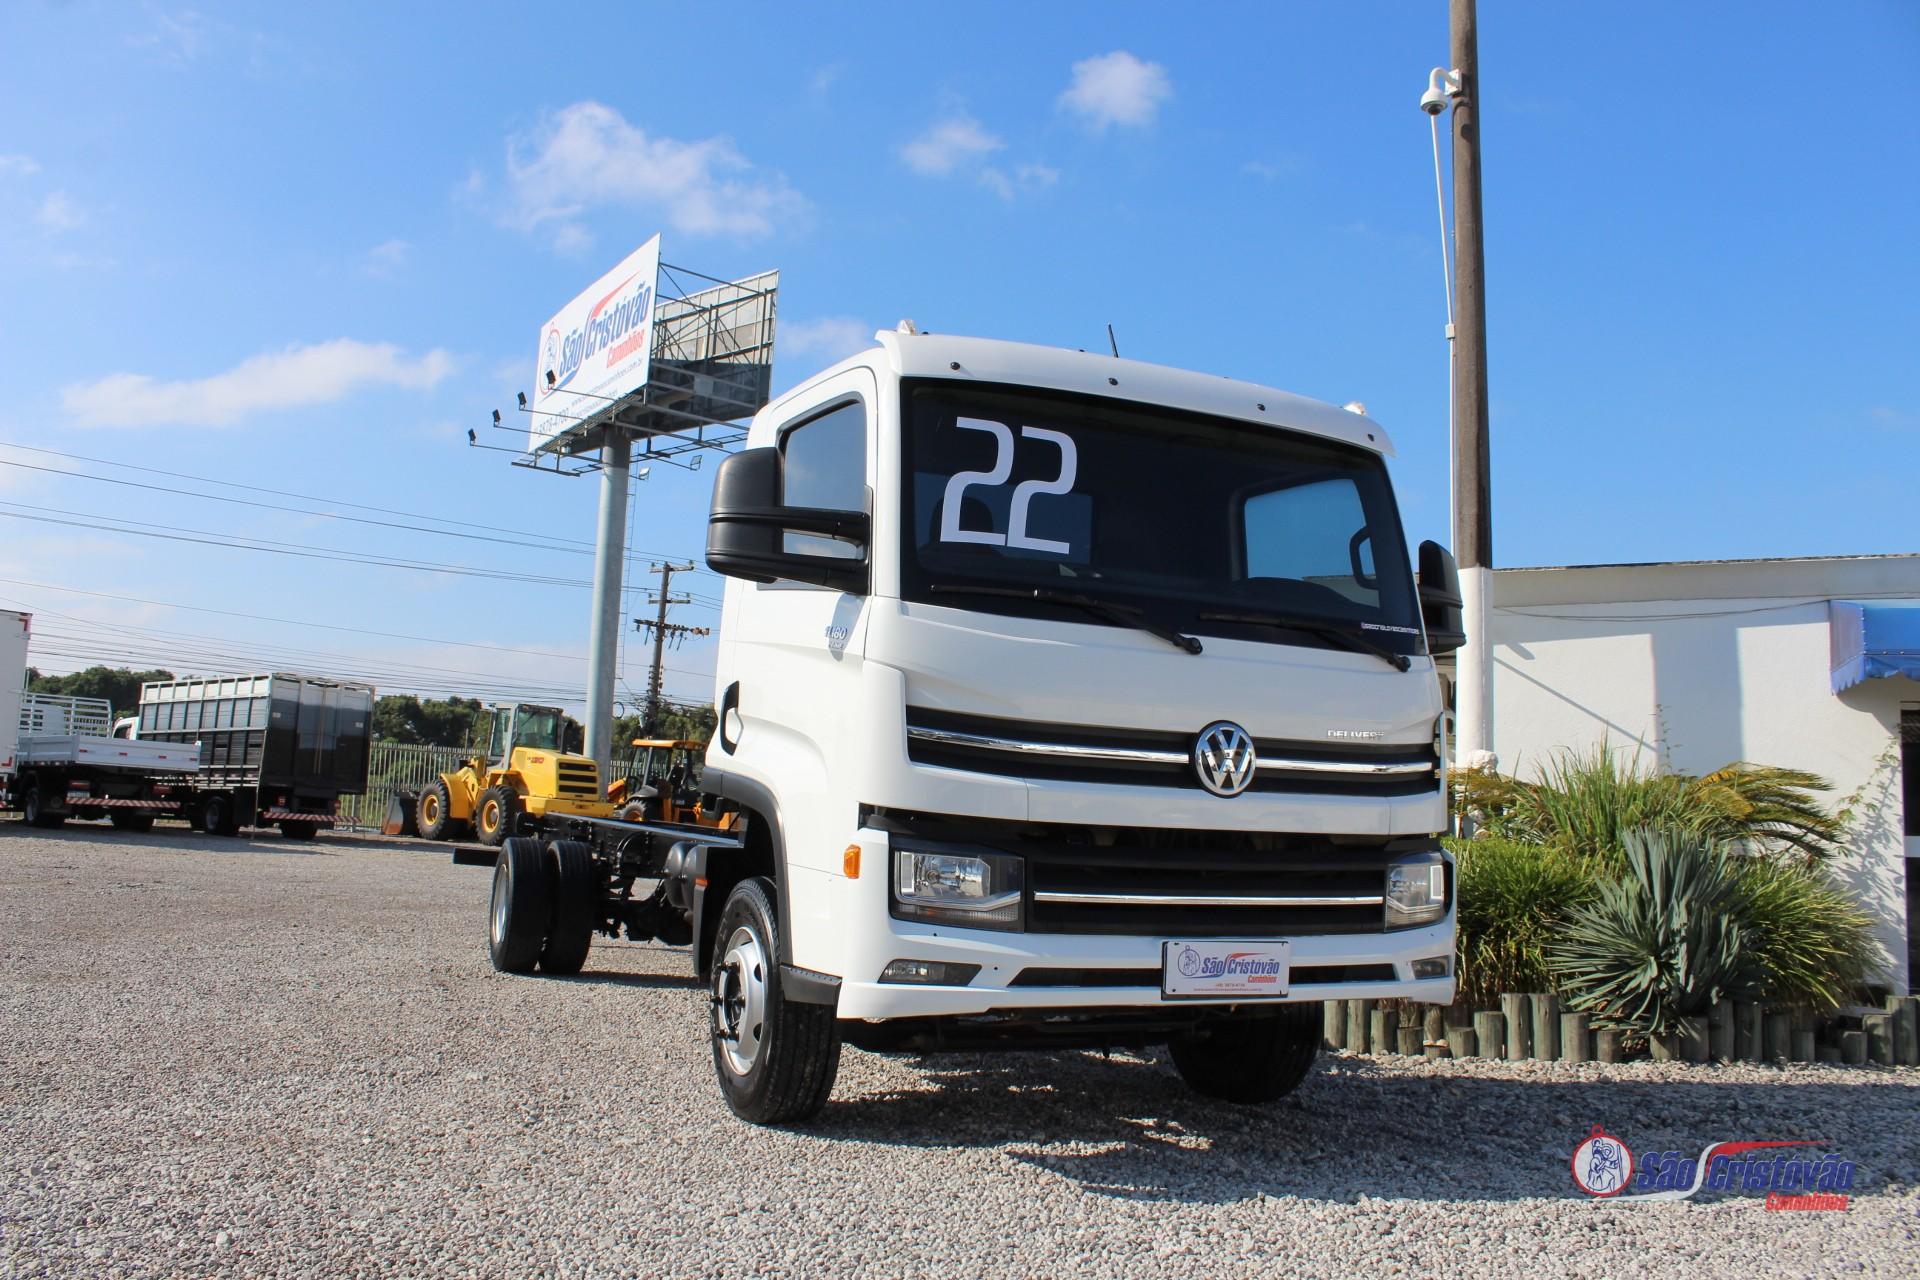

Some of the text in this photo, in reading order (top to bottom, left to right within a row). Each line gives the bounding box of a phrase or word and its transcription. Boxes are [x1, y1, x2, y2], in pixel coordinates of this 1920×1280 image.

[559, 280, 652, 378] São Cristóvão
[940, 416, 1078, 555] 22
[1201, 957, 1280, 975] São Cristóvão
